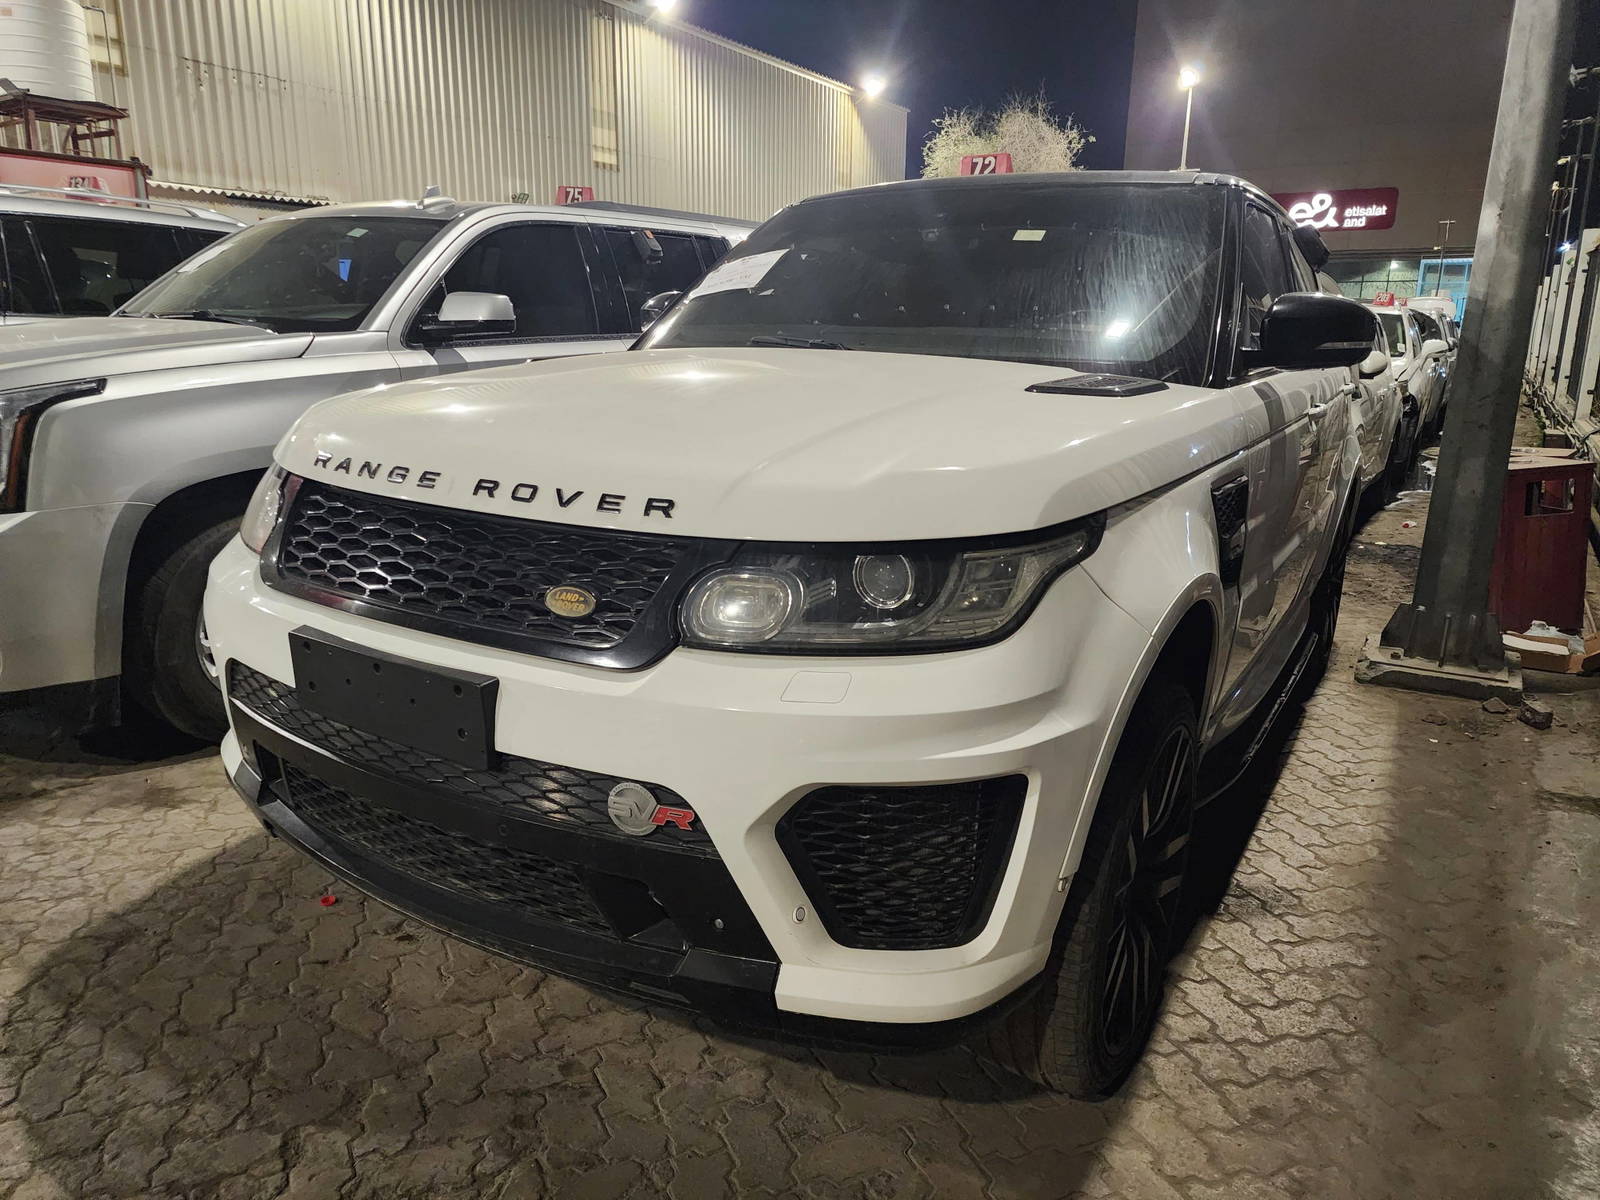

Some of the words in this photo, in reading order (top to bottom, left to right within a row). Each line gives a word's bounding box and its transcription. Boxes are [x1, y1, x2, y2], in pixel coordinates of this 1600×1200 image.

[972, 156, 996, 176] 72
[566, 188, 582, 204] 75
[1344, 204, 1388, 217] etisalat
[1343, 216, 1366, 228] and
[313, 450, 442, 490] RANGE
[472, 478, 676, 519] ROVER
